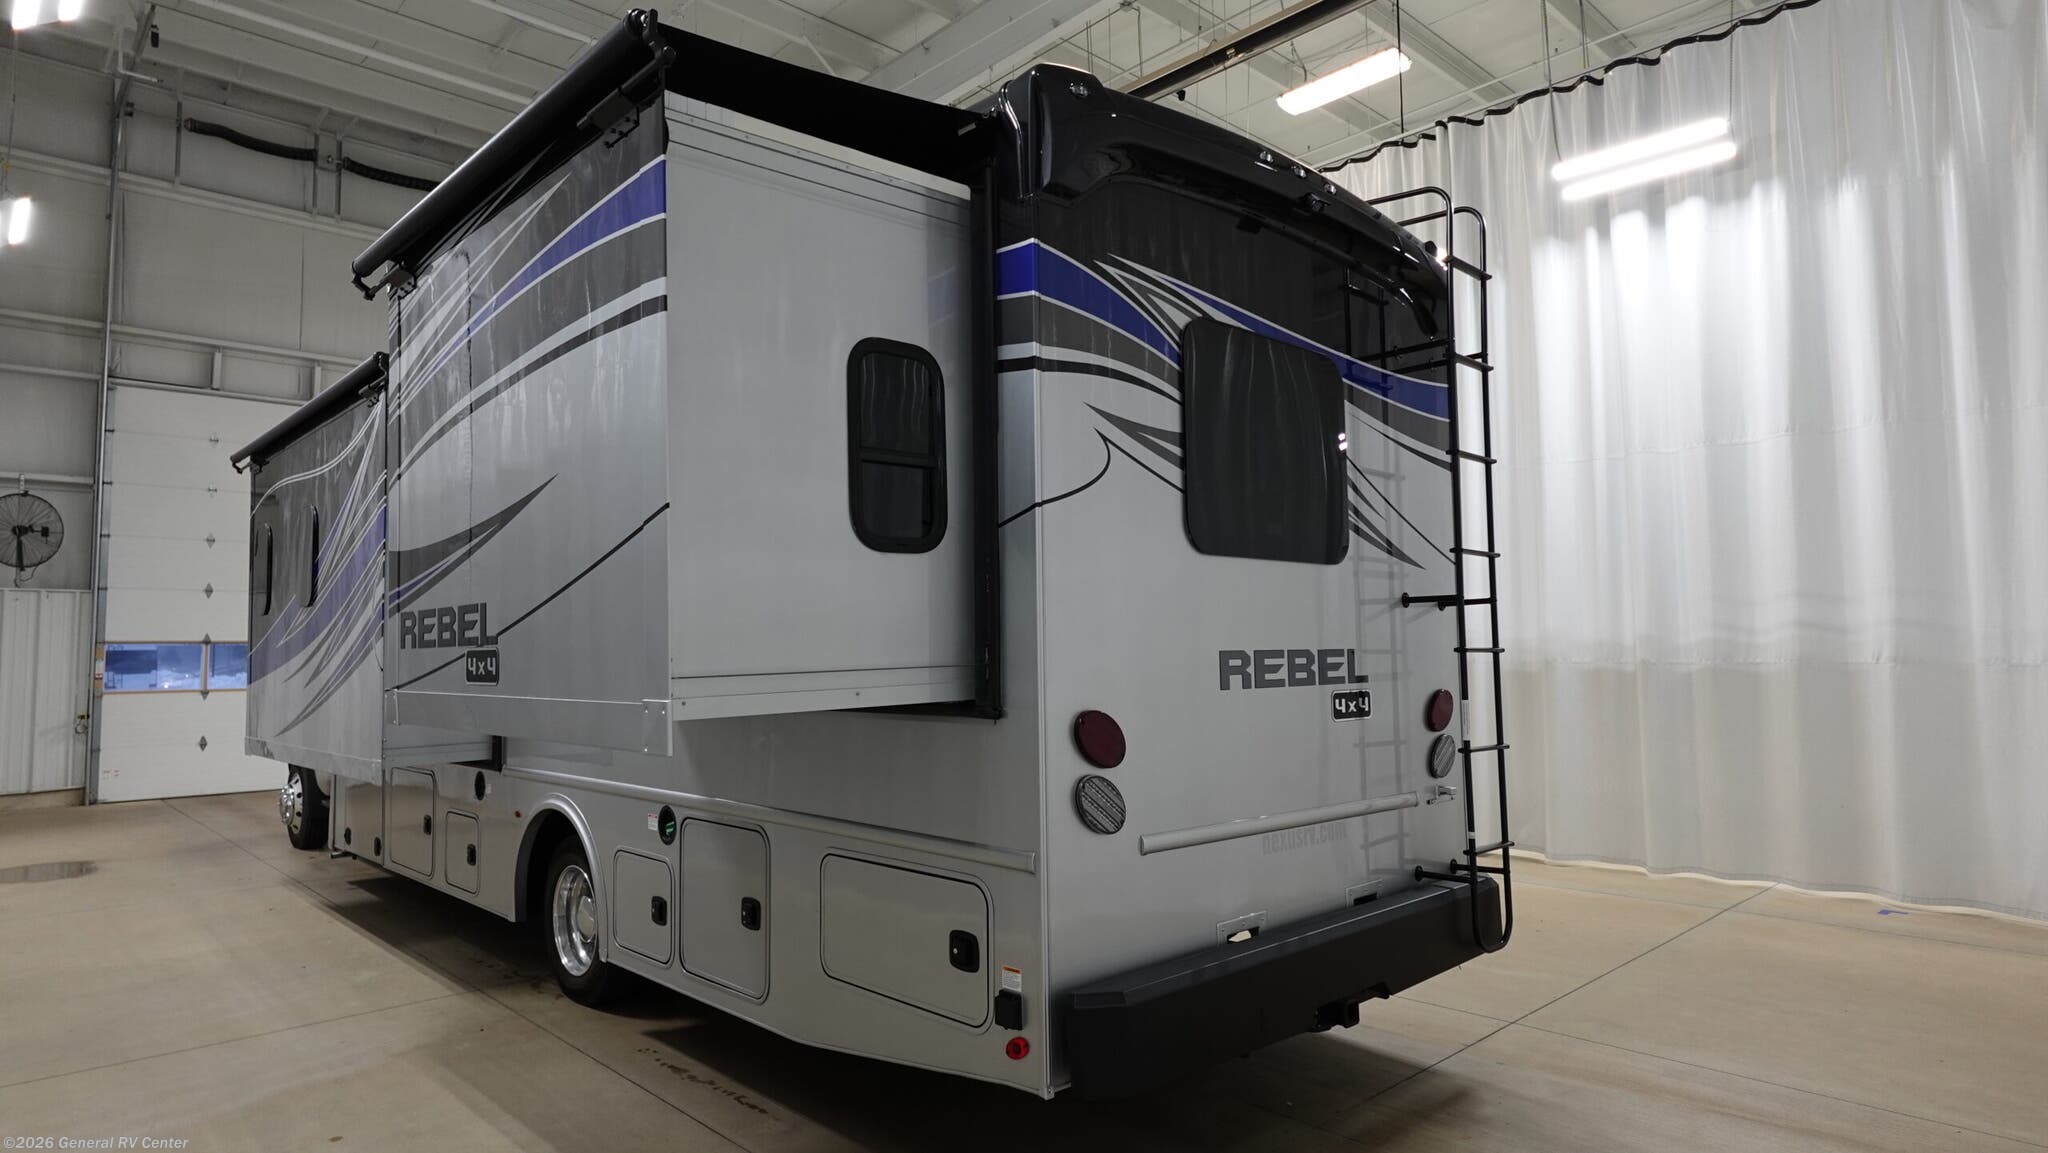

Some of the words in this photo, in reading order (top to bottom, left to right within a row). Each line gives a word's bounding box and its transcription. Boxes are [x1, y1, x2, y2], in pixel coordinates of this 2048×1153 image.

[400, 602, 498, 649] REBEL
[467, 657, 496, 675] 4x4
[1219, 649, 1368, 690] REBEL
[1335, 697, 1369, 713] 4x4
